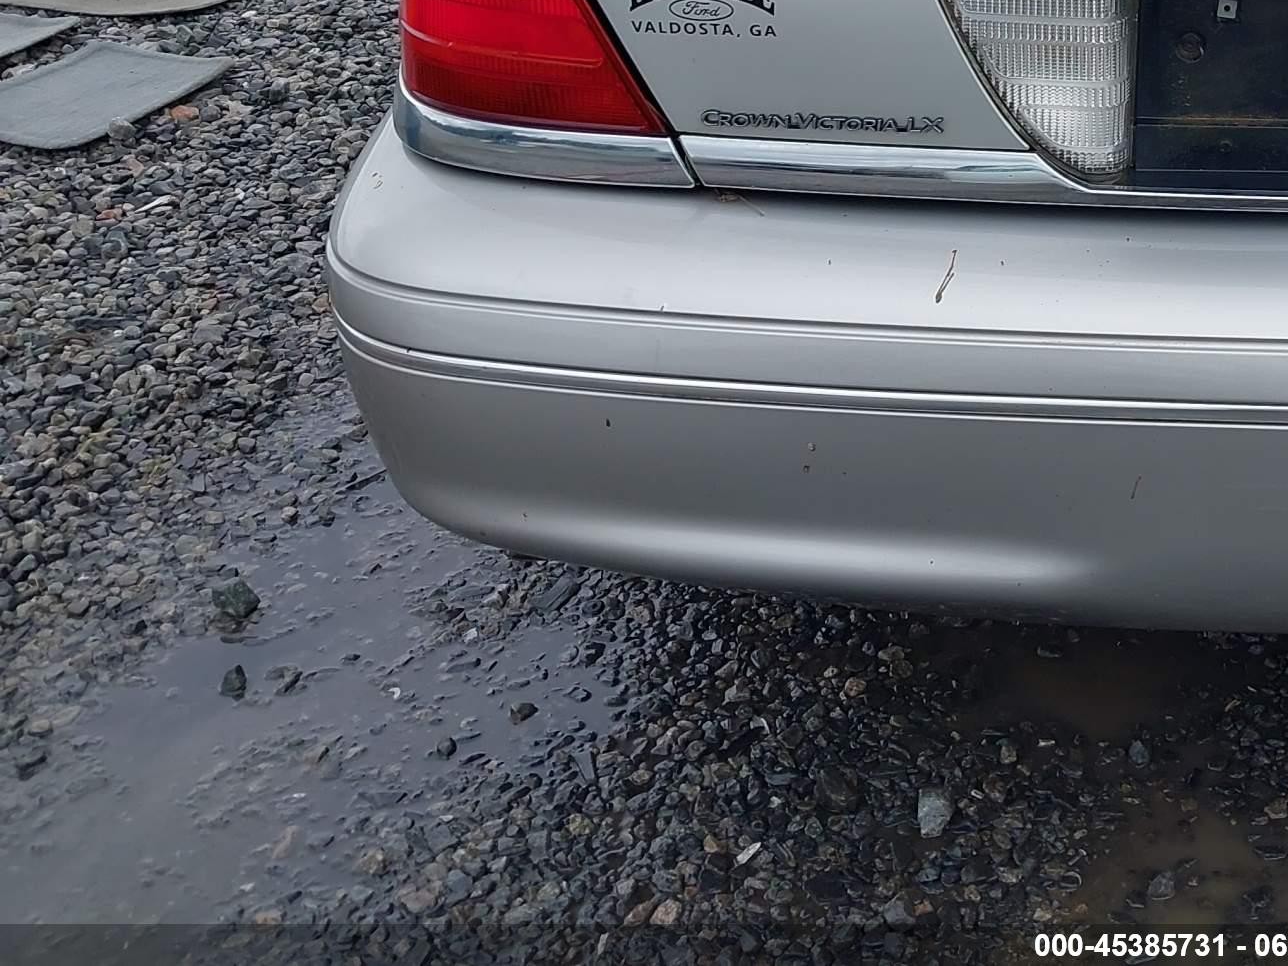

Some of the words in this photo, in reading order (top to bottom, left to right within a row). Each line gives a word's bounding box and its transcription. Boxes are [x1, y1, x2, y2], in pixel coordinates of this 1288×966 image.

[681, 1, 721, 17] Ford
[631, 20, 741, 38] VALDOSTA,
[749, 24, 777, 37] GA
[905, 117, 945, 135] LX
